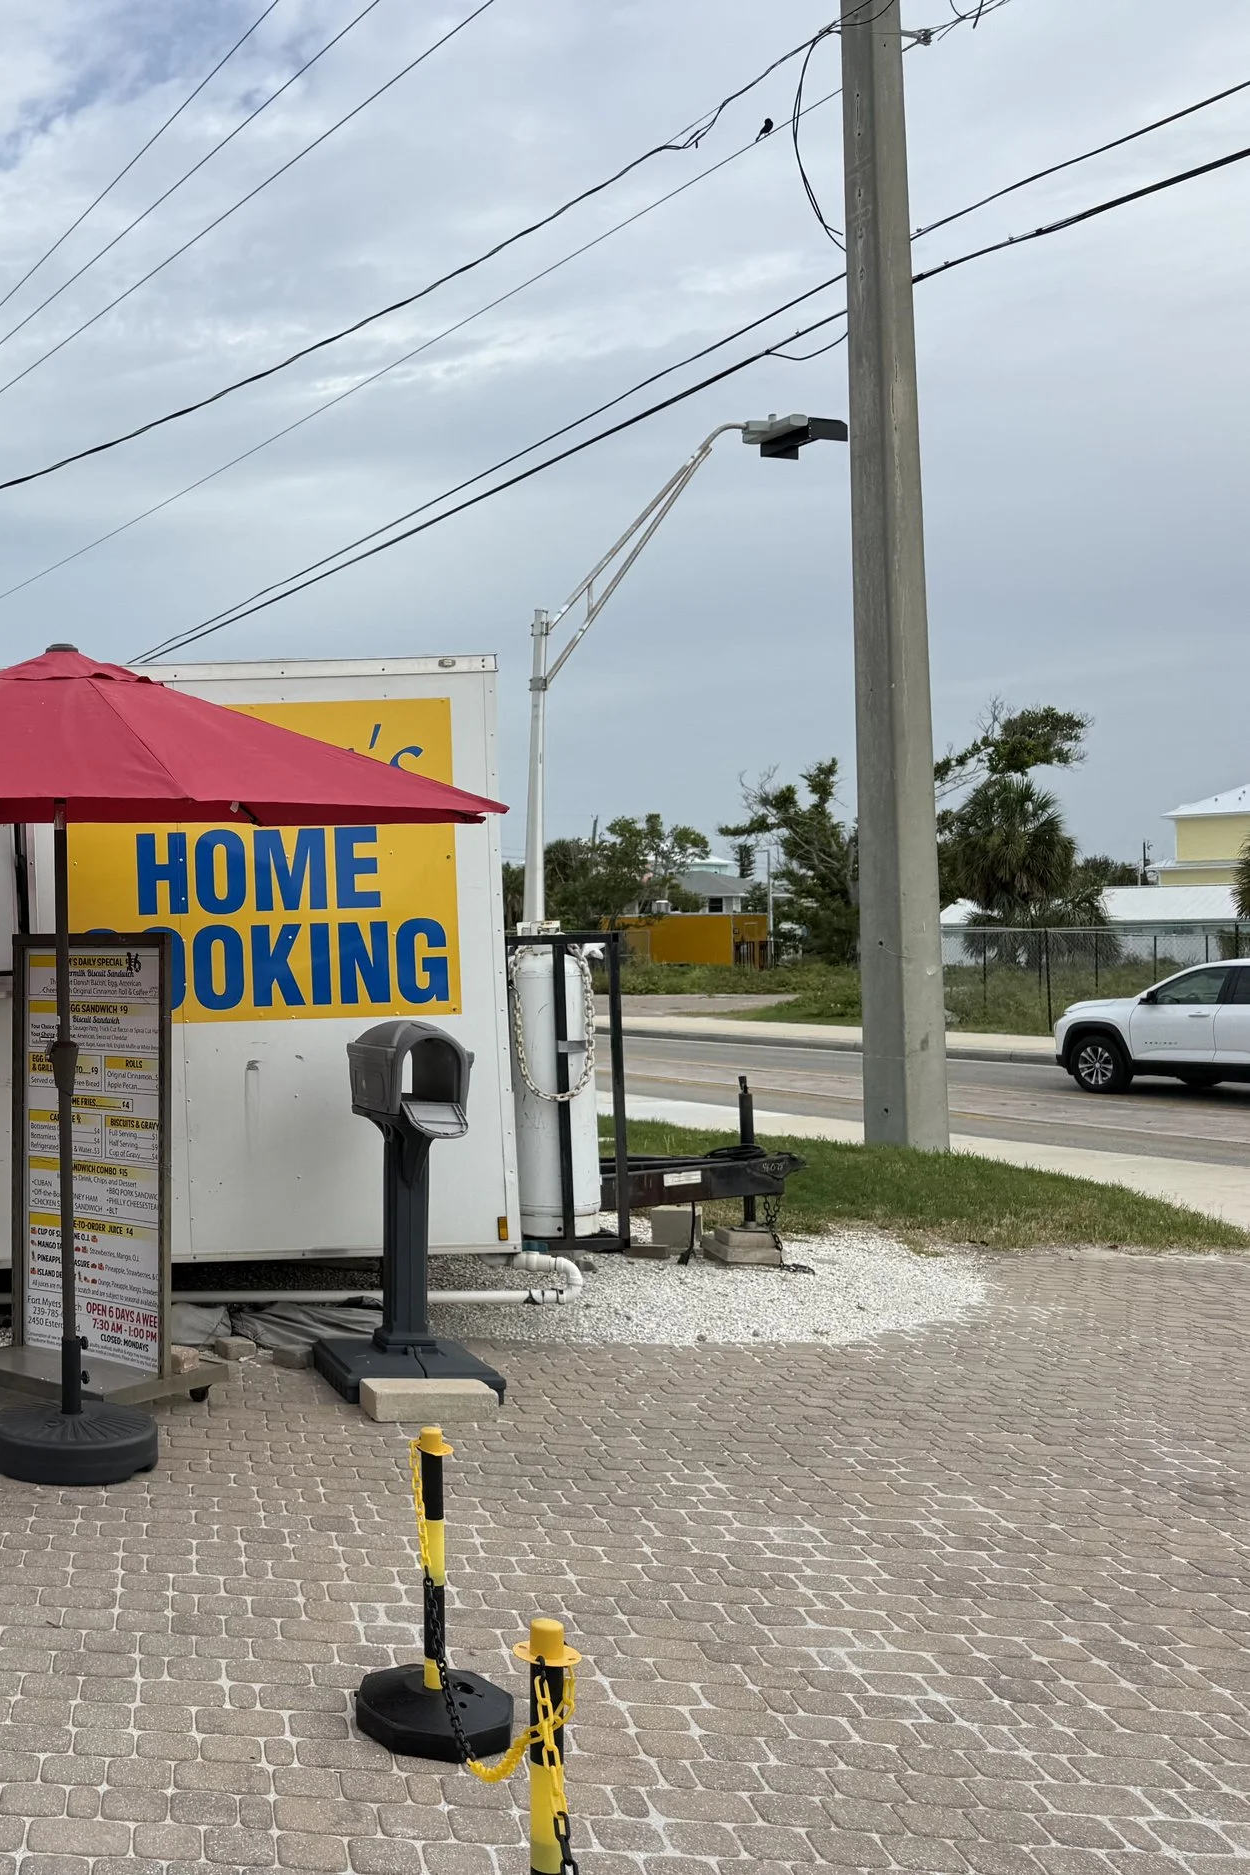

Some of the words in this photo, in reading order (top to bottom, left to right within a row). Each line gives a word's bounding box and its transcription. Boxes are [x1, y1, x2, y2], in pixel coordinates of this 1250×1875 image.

[136, 826, 382, 916] HOME
[79, 958, 95, 966] DAILY
[97, 958, 123, 966] SPECIAL
[140, 918, 450, 1011] OKING
[106, 970, 134, 978] Sandwich
[82, 1004, 118, 1014] SANDWICH
[120, 1005, 128, 1014] $9
[72, 1015, 91, 1023] Biscuit
[92, 1016, 120, 1024] Sandwich
[126, 1060, 143, 1068] ROLLS
[107, 1071, 127, 1079] Original
[108, 1082, 121, 1090] Apple
[81, 1098, 96, 1107] FRIES
[122, 1100, 130, 1109] $4
[110, 1120, 134, 1128] BISCUITS
[141, 1121, 159, 1131] GRAVY
[118, 1129, 137, 1138] Serving
[31, 1142, 59, 1151] Refrigerated
[119, 1140, 138, 1149] Serving
[126, 1150, 140, 1159] Gravy
[96, 1166, 117, 1175] COMBO
[119, 1168, 128, 1177] $15
[78, 1175, 93, 1183] Drink,
[94, 1176, 107, 1184] Chips
[108, 1177, 118, 1185] and
[118, 1179, 137, 1188] Dessert
[109, 1187, 119, 1195] BBQ
[120, 1188, 134, 1197] PORK
[134, 1190, 158, 1200] SANDWIC
[109, 1196, 126, 1205] PHILLY
[33, 1198, 56, 1207] CHICKEN
[75, 1202, 102, 1213] SANDWICH
[109, 1207, 118, 1215] BLT
[48, 1229, 55, 1237] OF
[108, 1225, 123, 1235] JUICE
[126, 1227, 134, 1236] $4
[37, 1240, 55, 1249] MANGO
[89, 1247, 116, 1259] Strawberries,
[116, 1251, 132, 1261] Mango,
[37, 1253, 62, 1264] PINEAPPL
[105, 1265, 125, 1275] Pineapple,
[126, 1267, 151, 1279] Strawberries,
[37, 1268, 54, 1277] ISLAND
[106, 1291, 119, 1300] subject
[27, 1296, 40, 1304] Fort
[42, 1298, 61, 1309] Myers
[86, 1302, 107, 1316] OPEN
[109, 1306, 114, 1318] 6
[116, 1307, 134, 1322] DAYS
[136, 1311, 141, 1323] A
[141, 1312, 158, 1328] WEE
[28, 1316, 43, 1325] 2450
[92, 1318, 110, 1330] 7:30
[111, 1320, 123, 1334] AM
[128, 1325, 144, 1338] 1:00
[146, 1328, 157, 1343] PM
[100, 1333, 122, 1345] CLOSED:
[123, 1339, 149, 1352] MONDAYS
